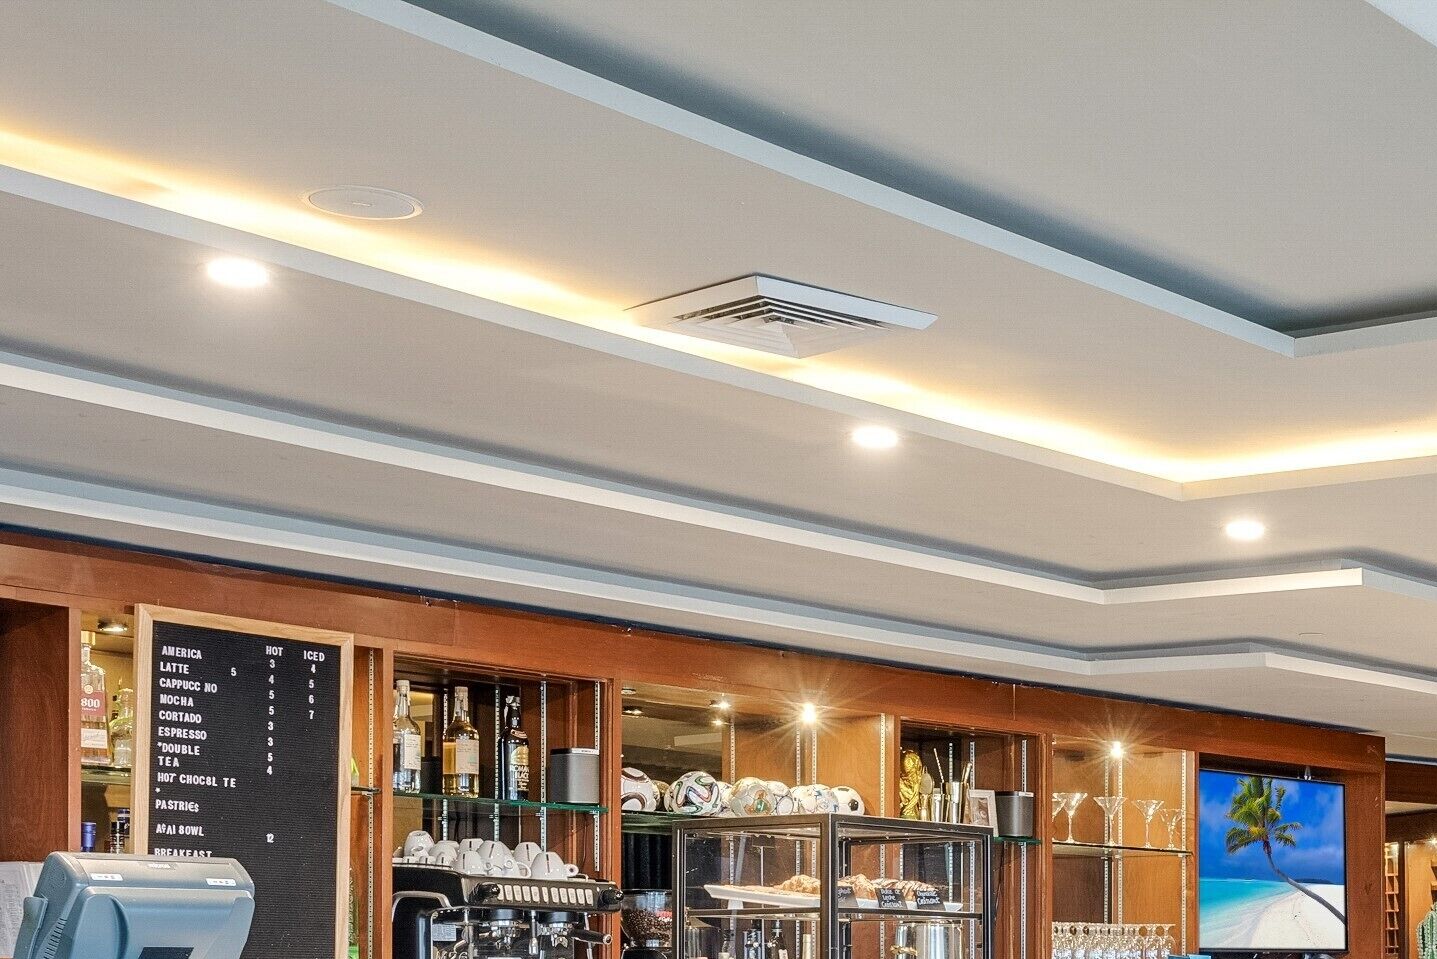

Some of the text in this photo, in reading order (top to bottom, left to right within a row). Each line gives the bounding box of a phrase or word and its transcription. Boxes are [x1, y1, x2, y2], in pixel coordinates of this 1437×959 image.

[161, 645, 202, 659] AMERICA
[265, 645, 325, 661] HOT ICED
[160, 662, 190, 674] LATTE
[269, 659, 275, 668] 3
[310, 664, 316, 673] 4
[231, 667, 237, 676] 5
[268, 674, 274, 684] 4
[308, 679, 315, 689] 5
[268, 690, 275, 699] 5
[308, 694, 315, 704] 6
[160, 694, 194, 707] MOCHA
[268, 706, 275, 715] 5
[309, 710, 315, 720] 7
[158, 710, 202, 724] CORTADO
[267, 721, 274, 731] 3
[158, 726, 207, 740] ESPRESSO
[267, 737, 274, 747] 3
[158, 756, 180, 767] TEA
[267, 752, 273, 762] 5
[266, 765, 273, 775] 4
[157, 772, 177, 783] HOT
[266, 833, 275, 843] 12
